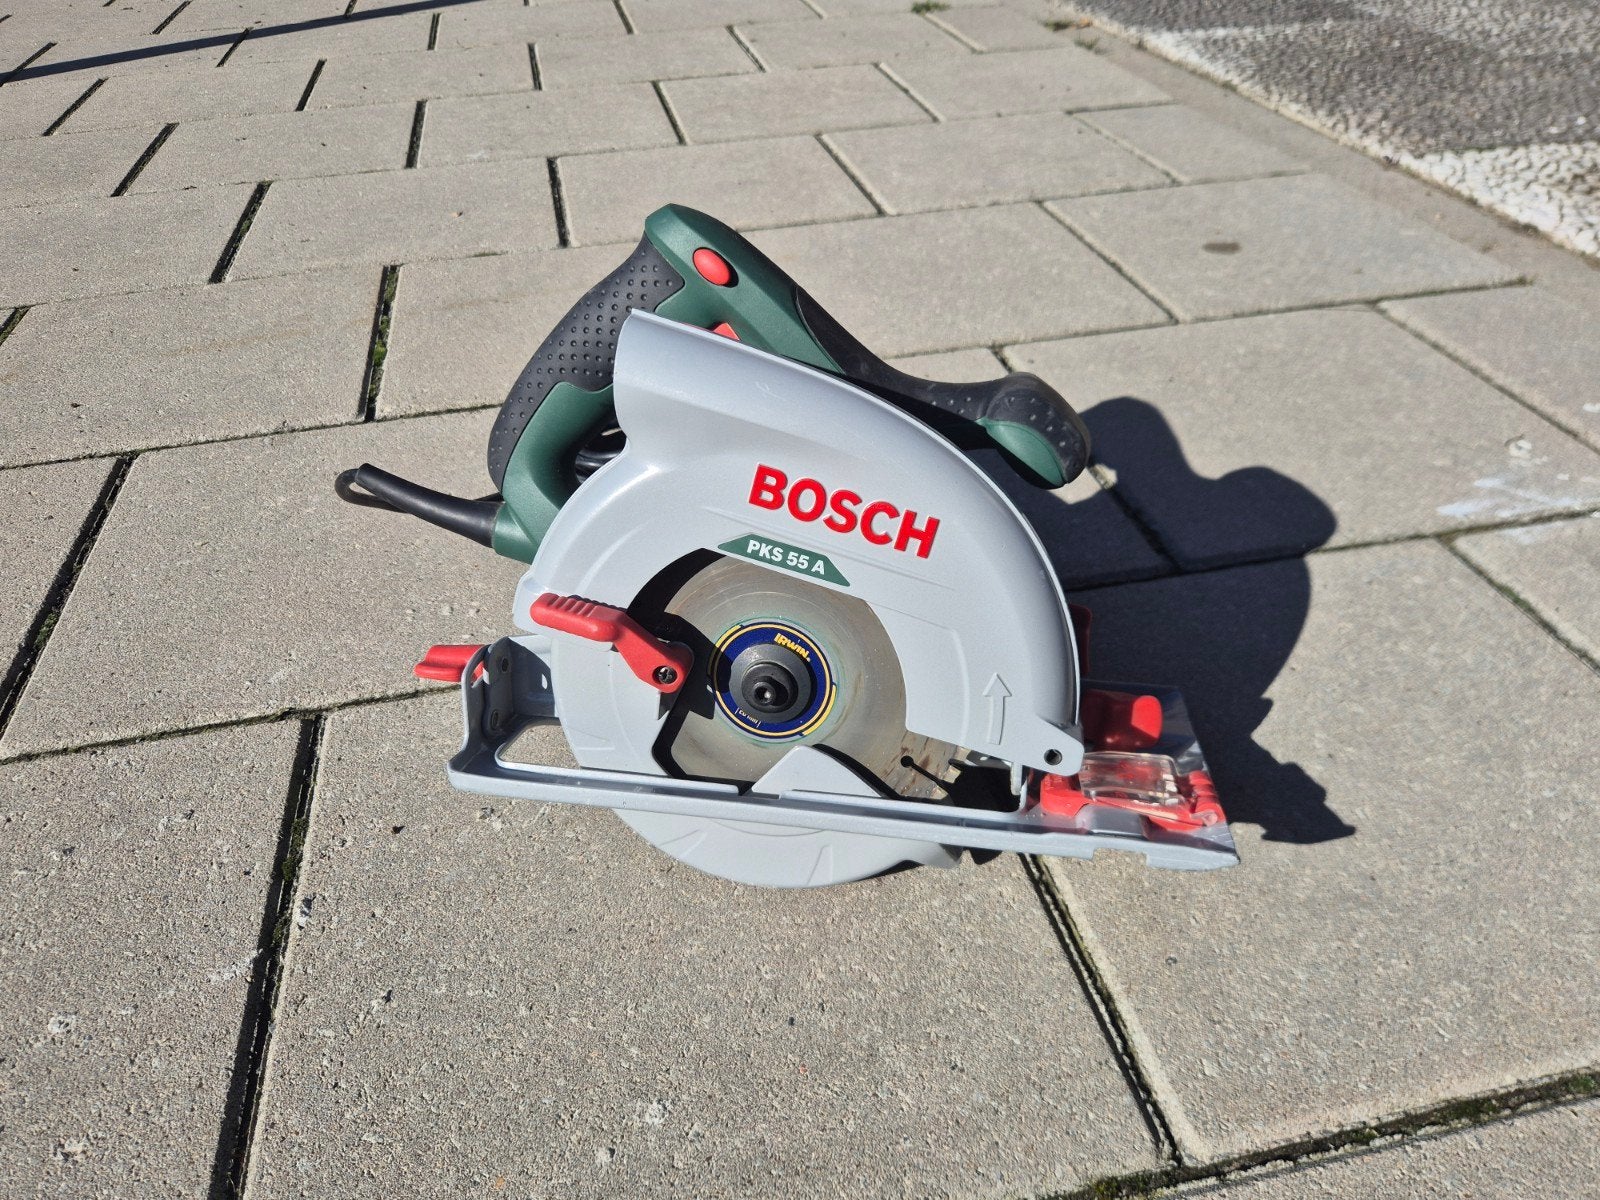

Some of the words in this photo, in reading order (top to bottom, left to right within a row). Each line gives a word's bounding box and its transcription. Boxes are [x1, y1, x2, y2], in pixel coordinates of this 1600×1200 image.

[748, 463, 941, 559] BOSCH
[746, 539, 784, 563] PKS
[786, 552, 810, 570] 55
[811, 560, 825, 575] A
